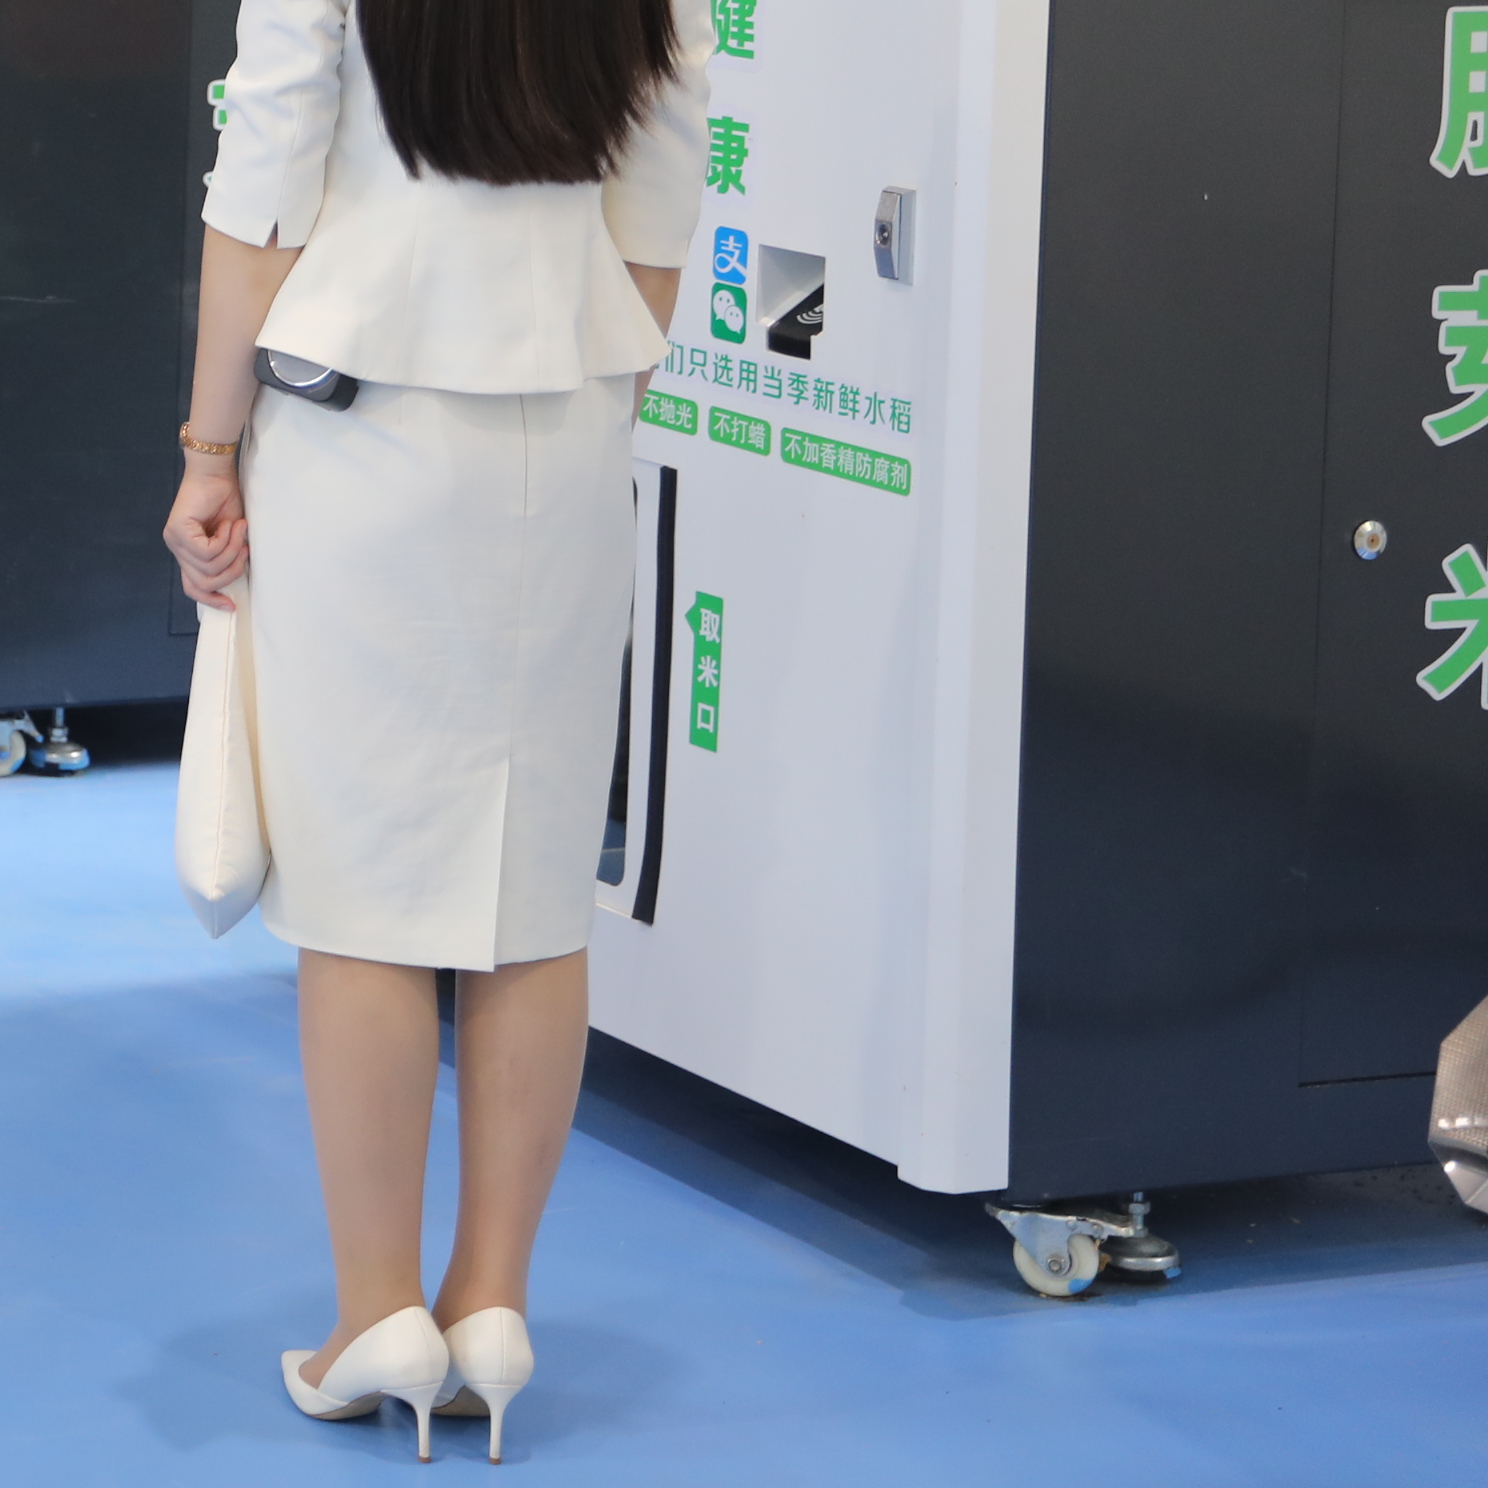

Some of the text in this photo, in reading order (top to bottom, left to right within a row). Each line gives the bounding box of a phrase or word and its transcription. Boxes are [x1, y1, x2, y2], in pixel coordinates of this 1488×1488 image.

[653, 340, 913, 435] 们只选用当季新鲜水稻
[642, 393, 909, 491] 不抛光 不打蜡 不加香精防腐剂
[696, 608, 721, 734] 取米口
